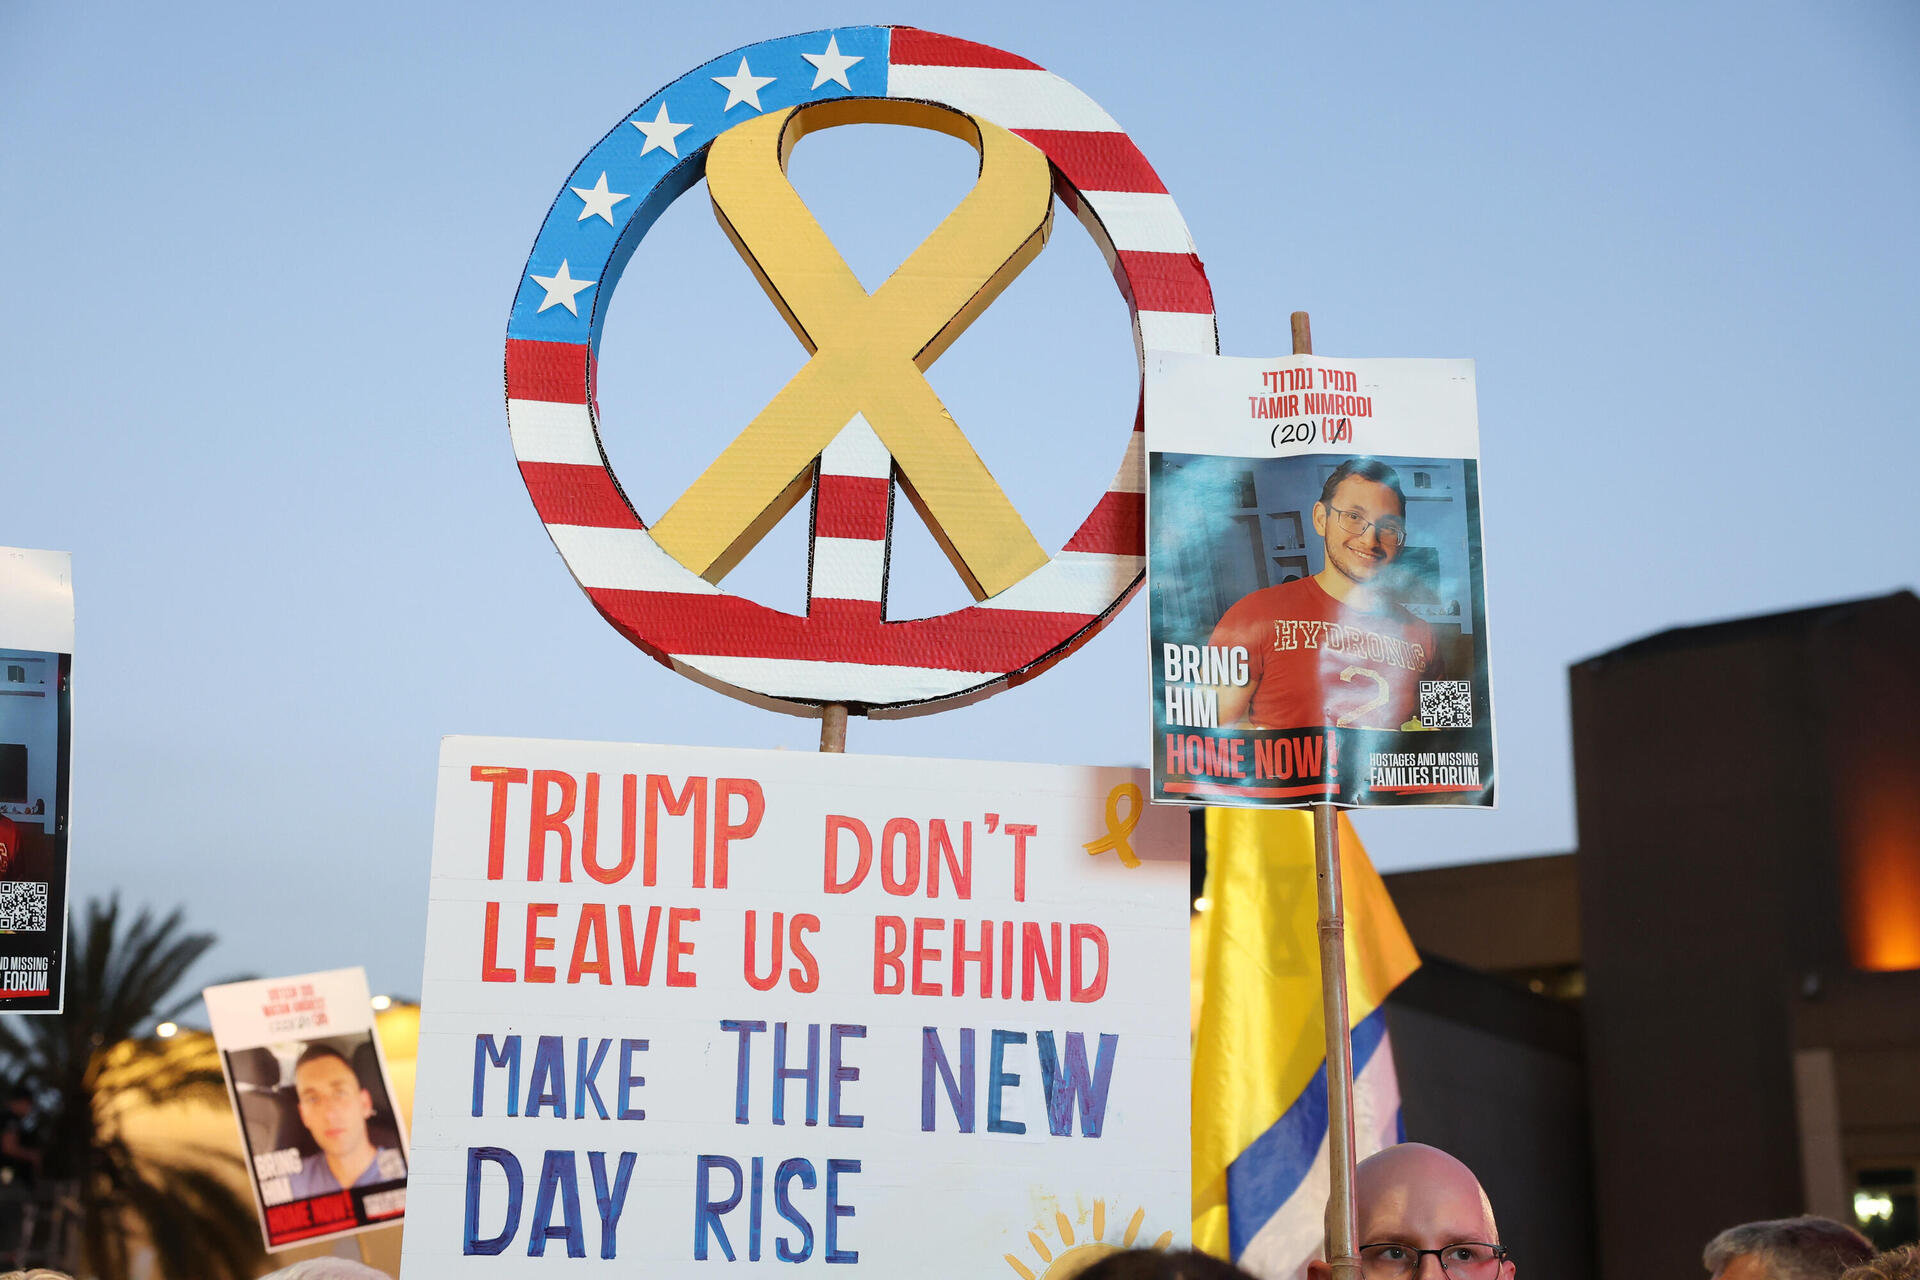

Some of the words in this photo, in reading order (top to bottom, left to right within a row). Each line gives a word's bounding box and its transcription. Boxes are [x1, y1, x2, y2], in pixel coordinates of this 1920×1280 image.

[1261, 367, 1313, 394] נמרודי
[1318, 367, 1358, 393] תמיר
[1248, 394, 1300, 419] TAMIR
[1304, 392, 1373, 418] NIMRODI
[1270, 420, 1317, 449] (20)
[1163, 642, 1249, 685] BRING
[1164, 686, 1218, 729] HIM
[1166, 733, 1247, 779] HOME
[1253, 729, 1340, 780] NOW!
[1368, 752, 1416, 767] HOSTAGES
[1417, 752, 1436, 766] AND
[1438, 752, 1479, 766] MISSING
[1370, 766, 1429, 786] FAMILIES
[1432, 766, 1480, 786] FORUM
[469, 765, 766, 889] TRUMP
[10, 956, 49, 971] MISSING
[481, 901, 702, 988] LEAVE
[743, 909, 821, 994] US
[873, 915, 1110, 1004] BEHIND
[3, 970, 48, 992] FORUM
[471, 1033, 650, 1121] MAKE
[719, 1019, 867, 1129] THE
[921, 1026, 1120, 1139] NEW
[463, 1146, 638, 1261] DAY
[693, 1153, 863, 1265] RISE
